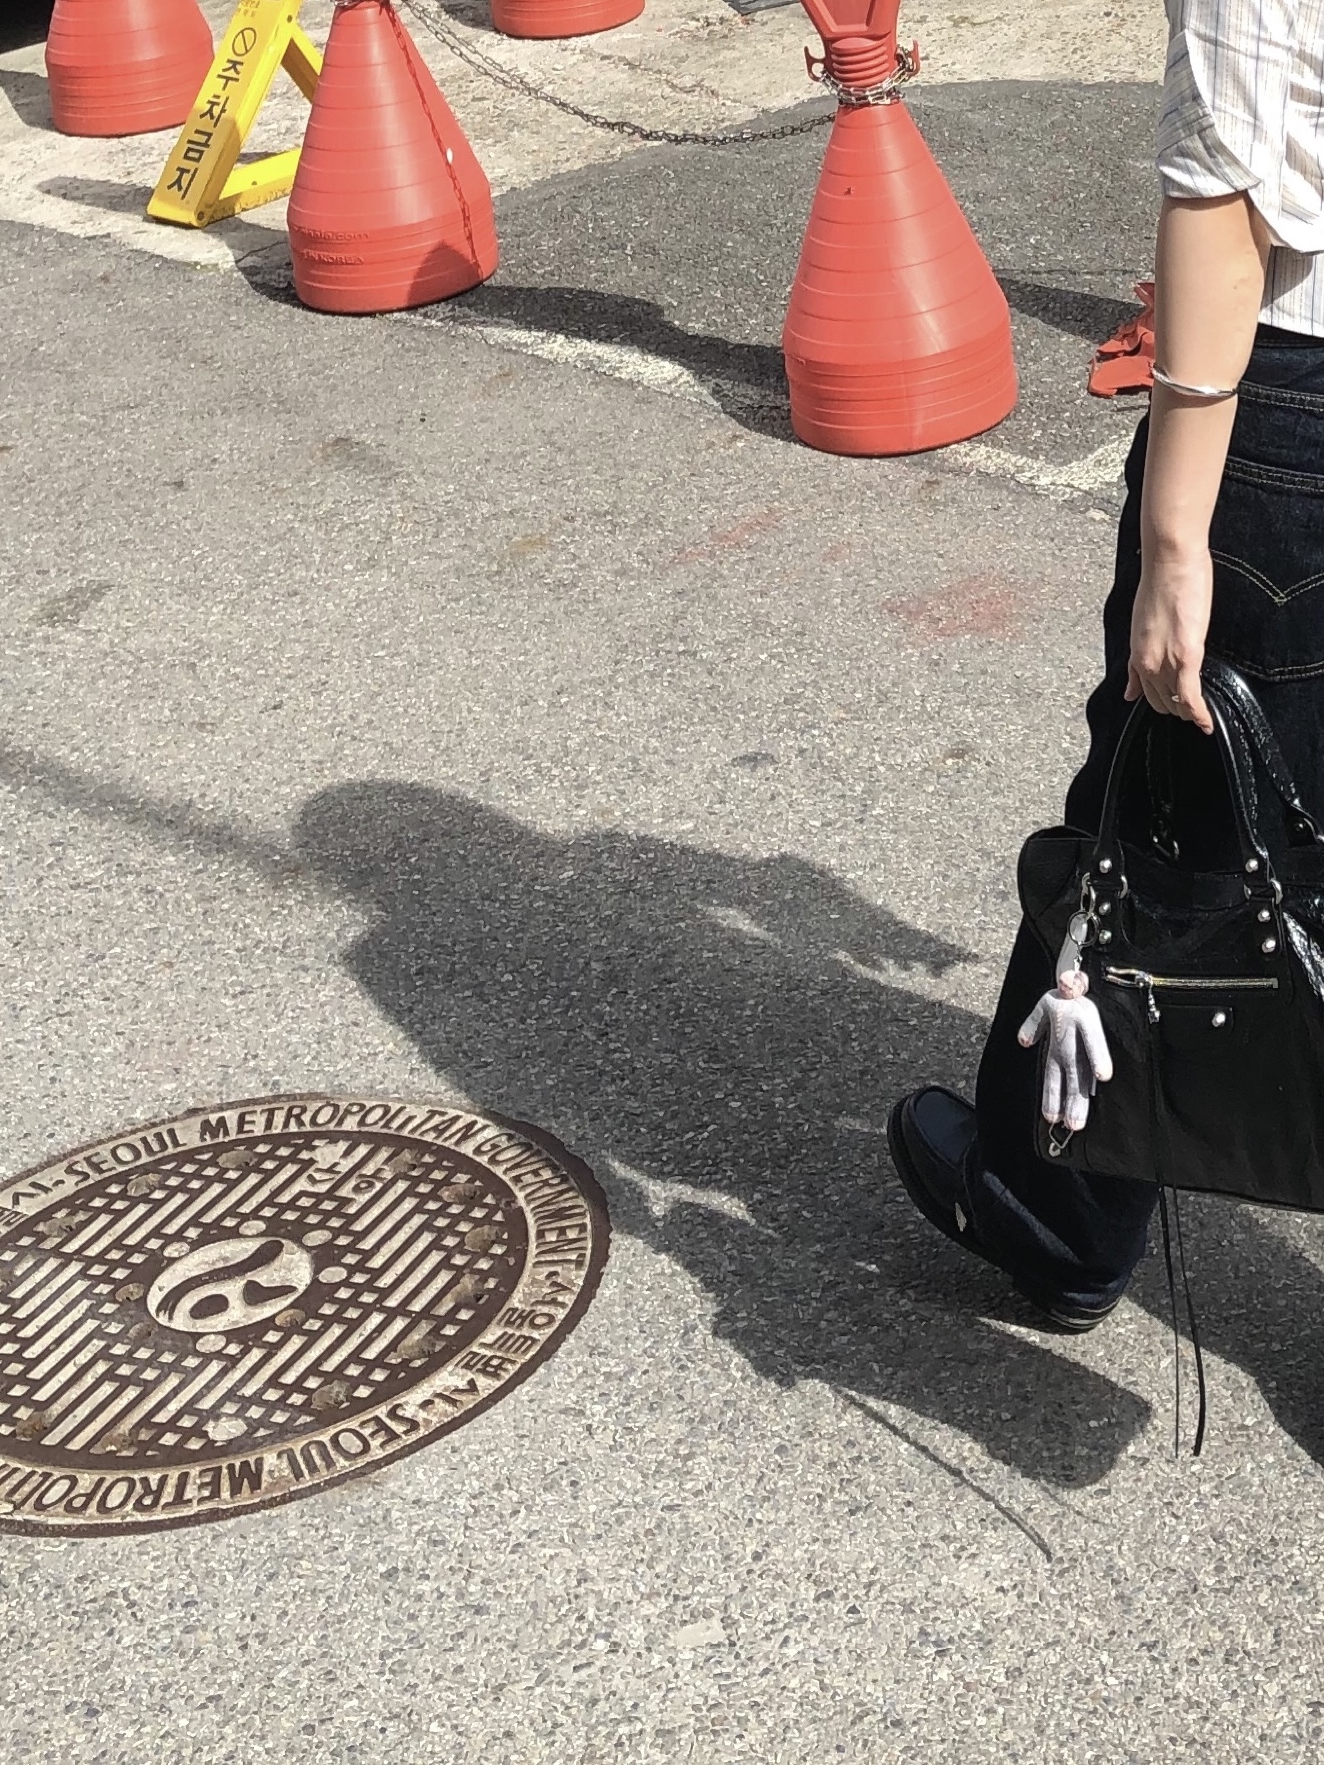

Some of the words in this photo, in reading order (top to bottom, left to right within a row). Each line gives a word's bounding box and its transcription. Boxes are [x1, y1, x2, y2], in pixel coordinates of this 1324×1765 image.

[166, 58, 245, 201] 주차금지
[64, 1127, 188, 1187] SEOUL
[200, 1101, 490, 1148] METROPOLITAN
[472, 1132, 589, 1270] GOVERNMENT
[432, 1280, 574, 1410] 서울특별시
[276, 1403, 421, 1484] SEOUL
